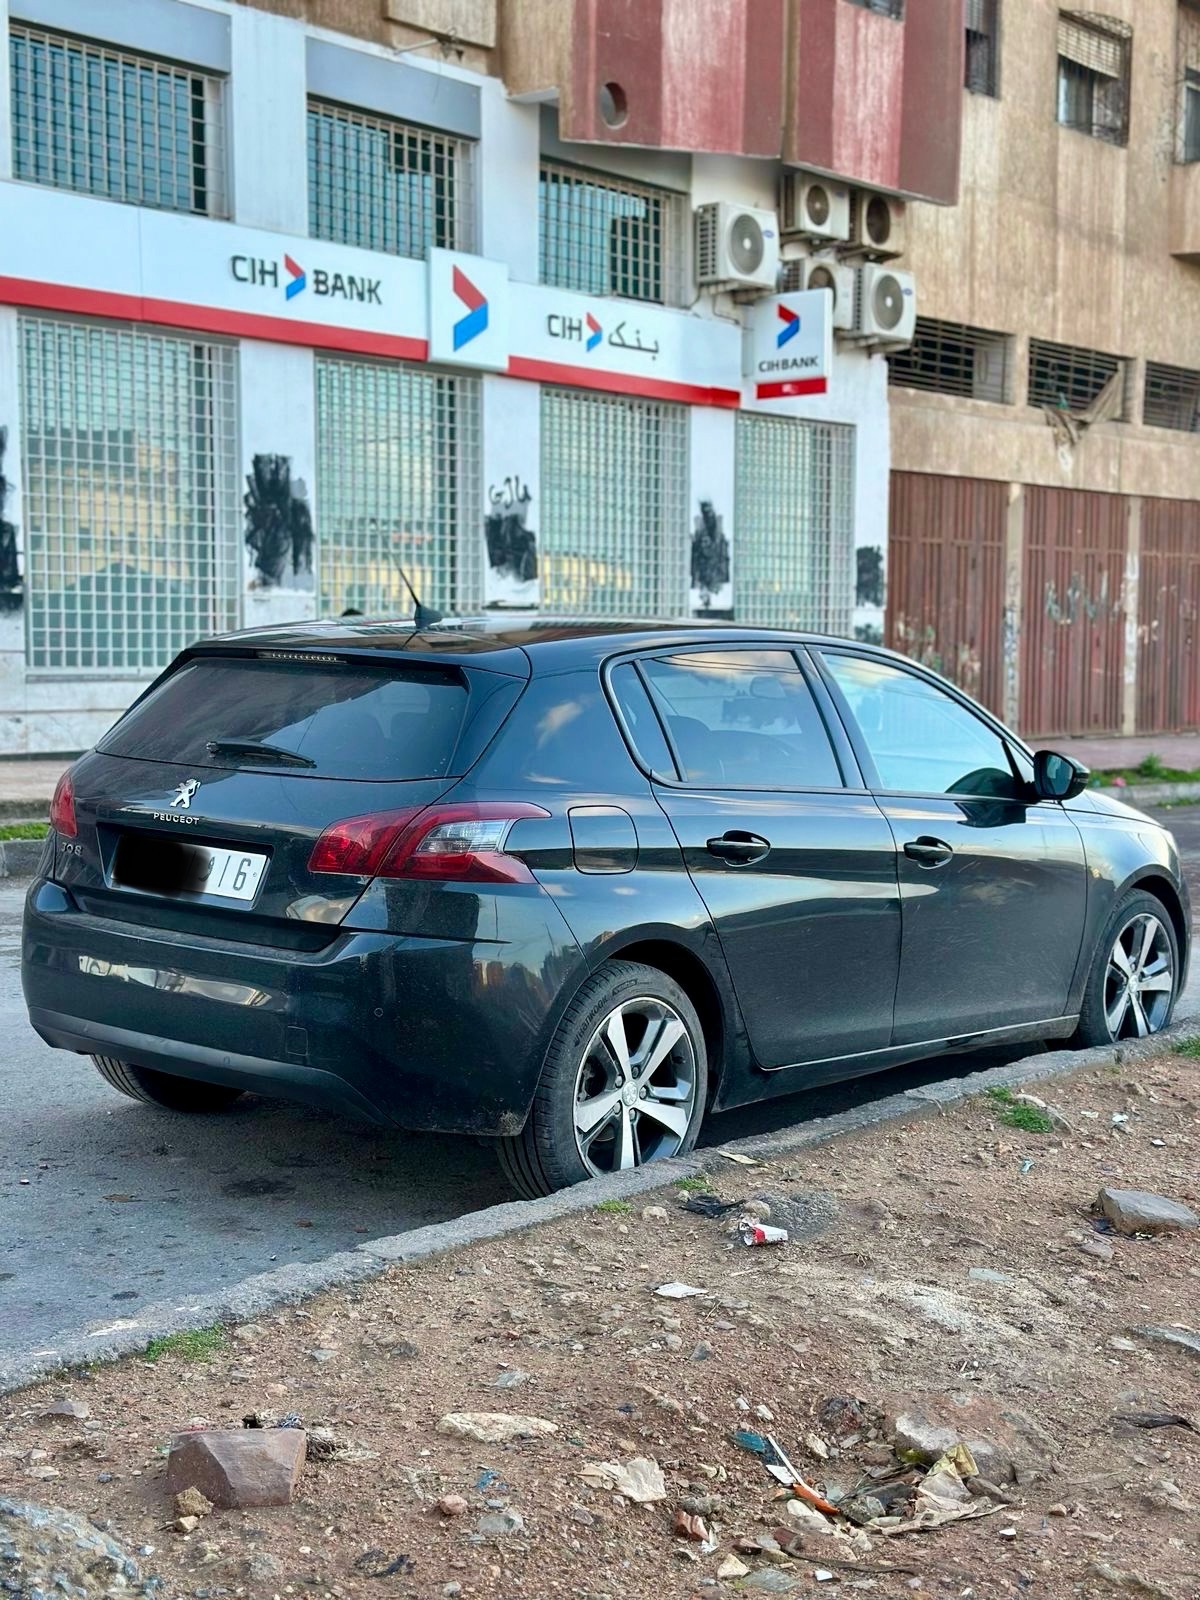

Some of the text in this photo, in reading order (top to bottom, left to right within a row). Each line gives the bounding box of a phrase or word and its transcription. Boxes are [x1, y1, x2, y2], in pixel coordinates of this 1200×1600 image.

[230, 255, 383, 305] CIH BANK
[547, 314, 660, 361] CIH بنك
[153, 812, 200, 825] PEUGEOT
